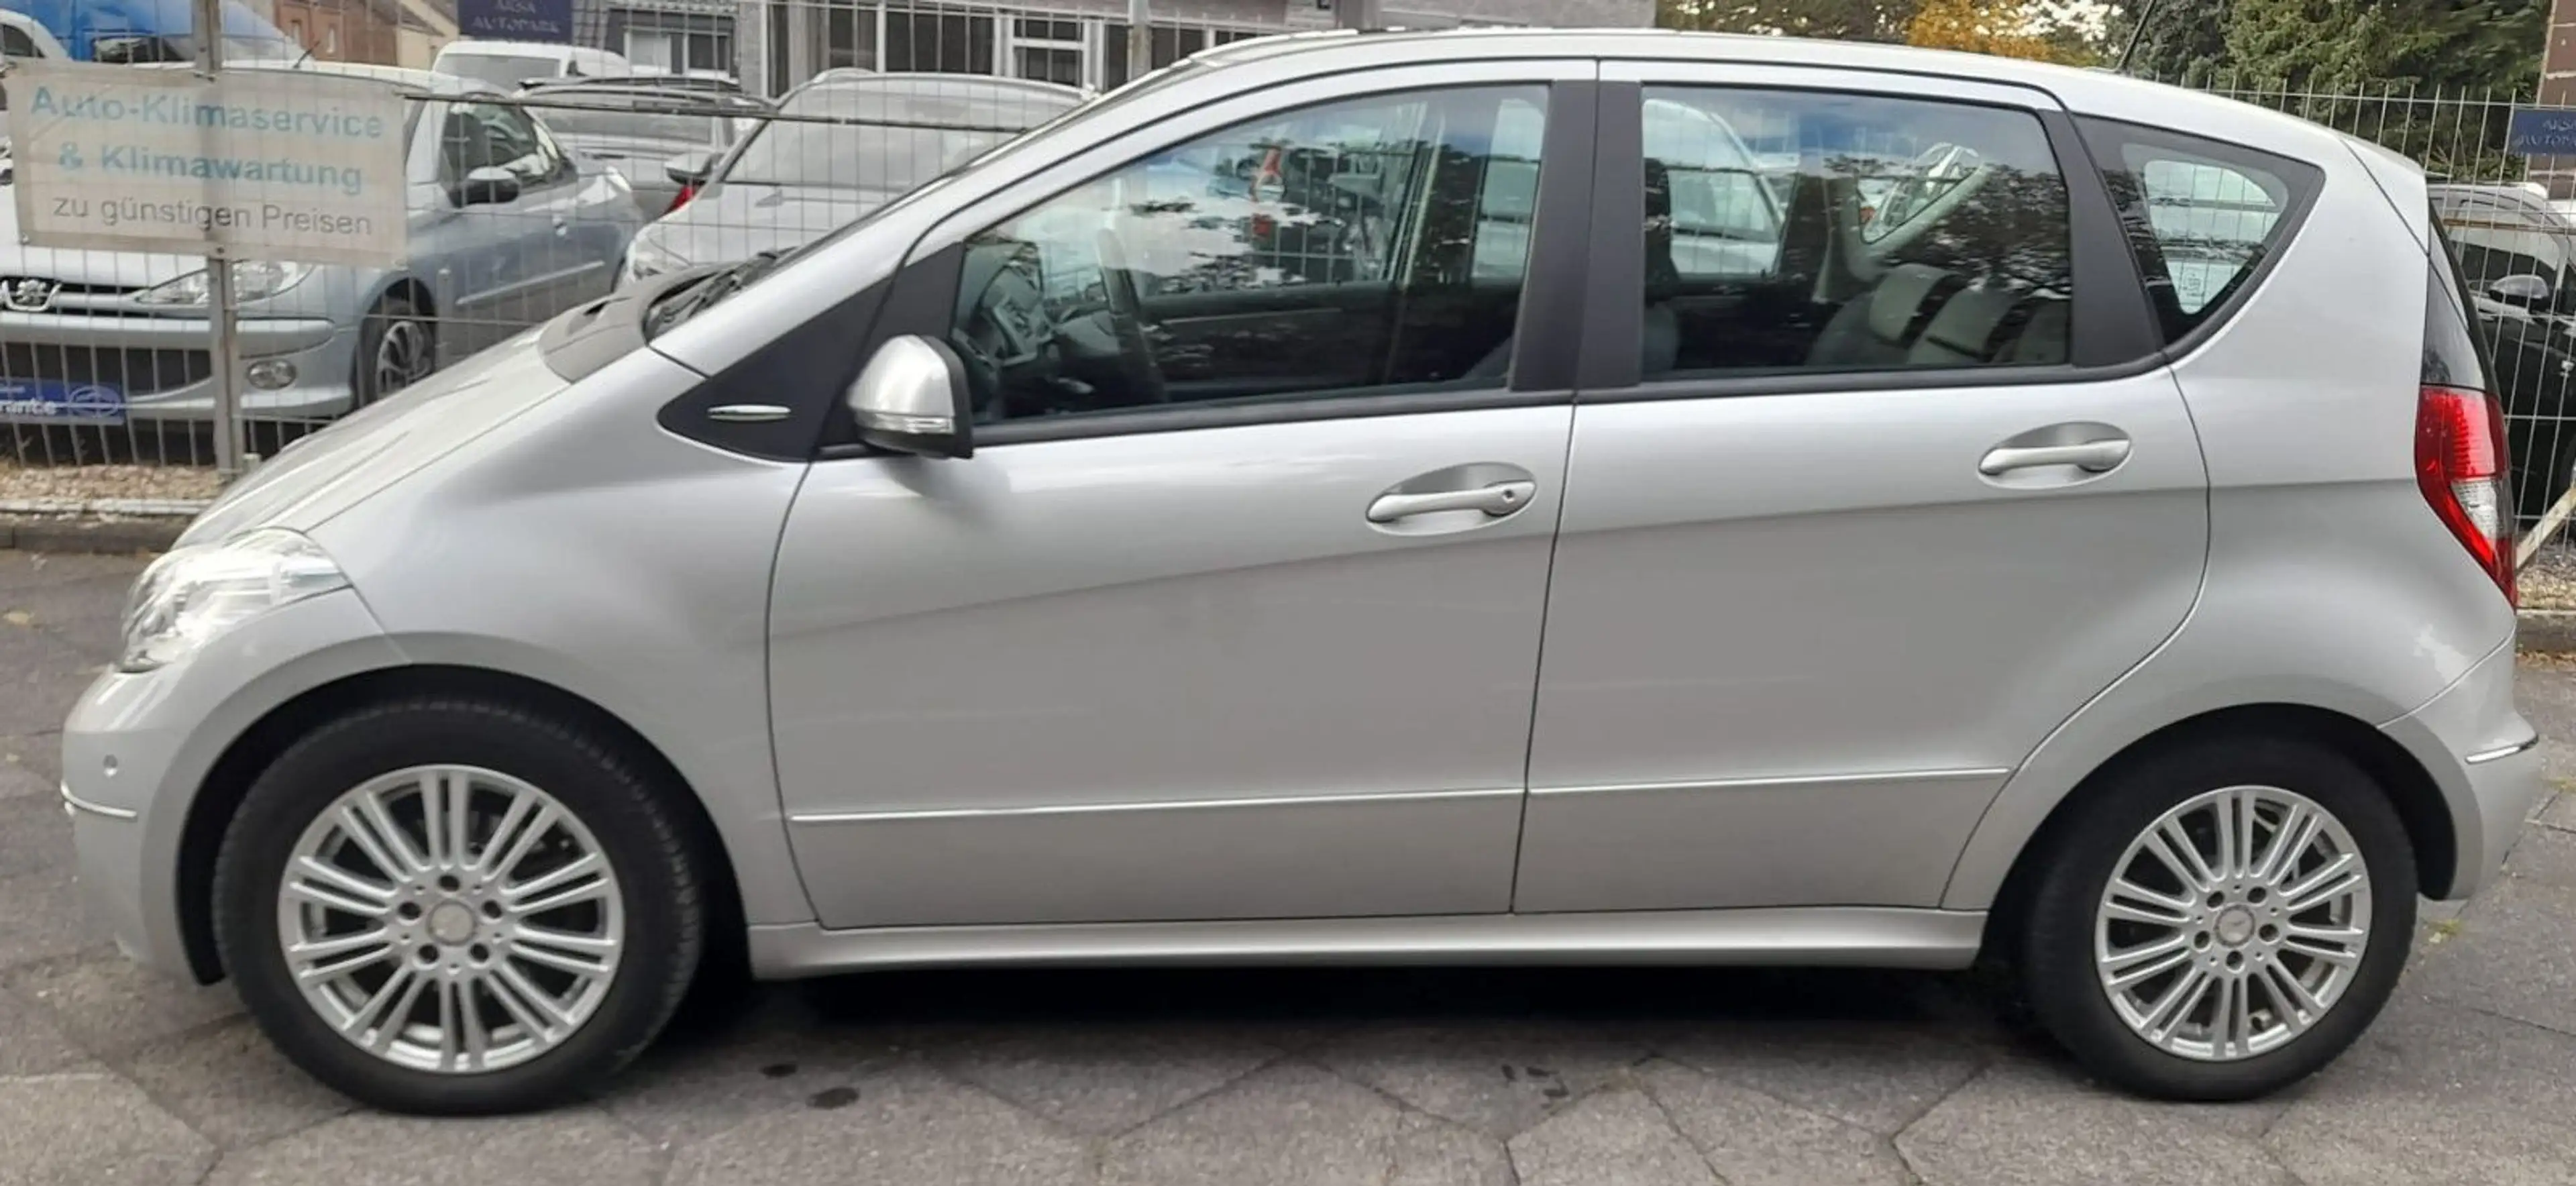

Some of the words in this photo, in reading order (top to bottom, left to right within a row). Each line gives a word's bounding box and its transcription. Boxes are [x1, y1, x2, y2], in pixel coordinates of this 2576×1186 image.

[31, 85, 382, 139] Auto-Klimaservice
[58, 141, 83, 170] &
[102, 144, 362, 196] Klimawartung
[52, 197, 89, 217] zu
[101, 197, 251, 231] günstigen
[262, 203, 372, 235] Preisen
